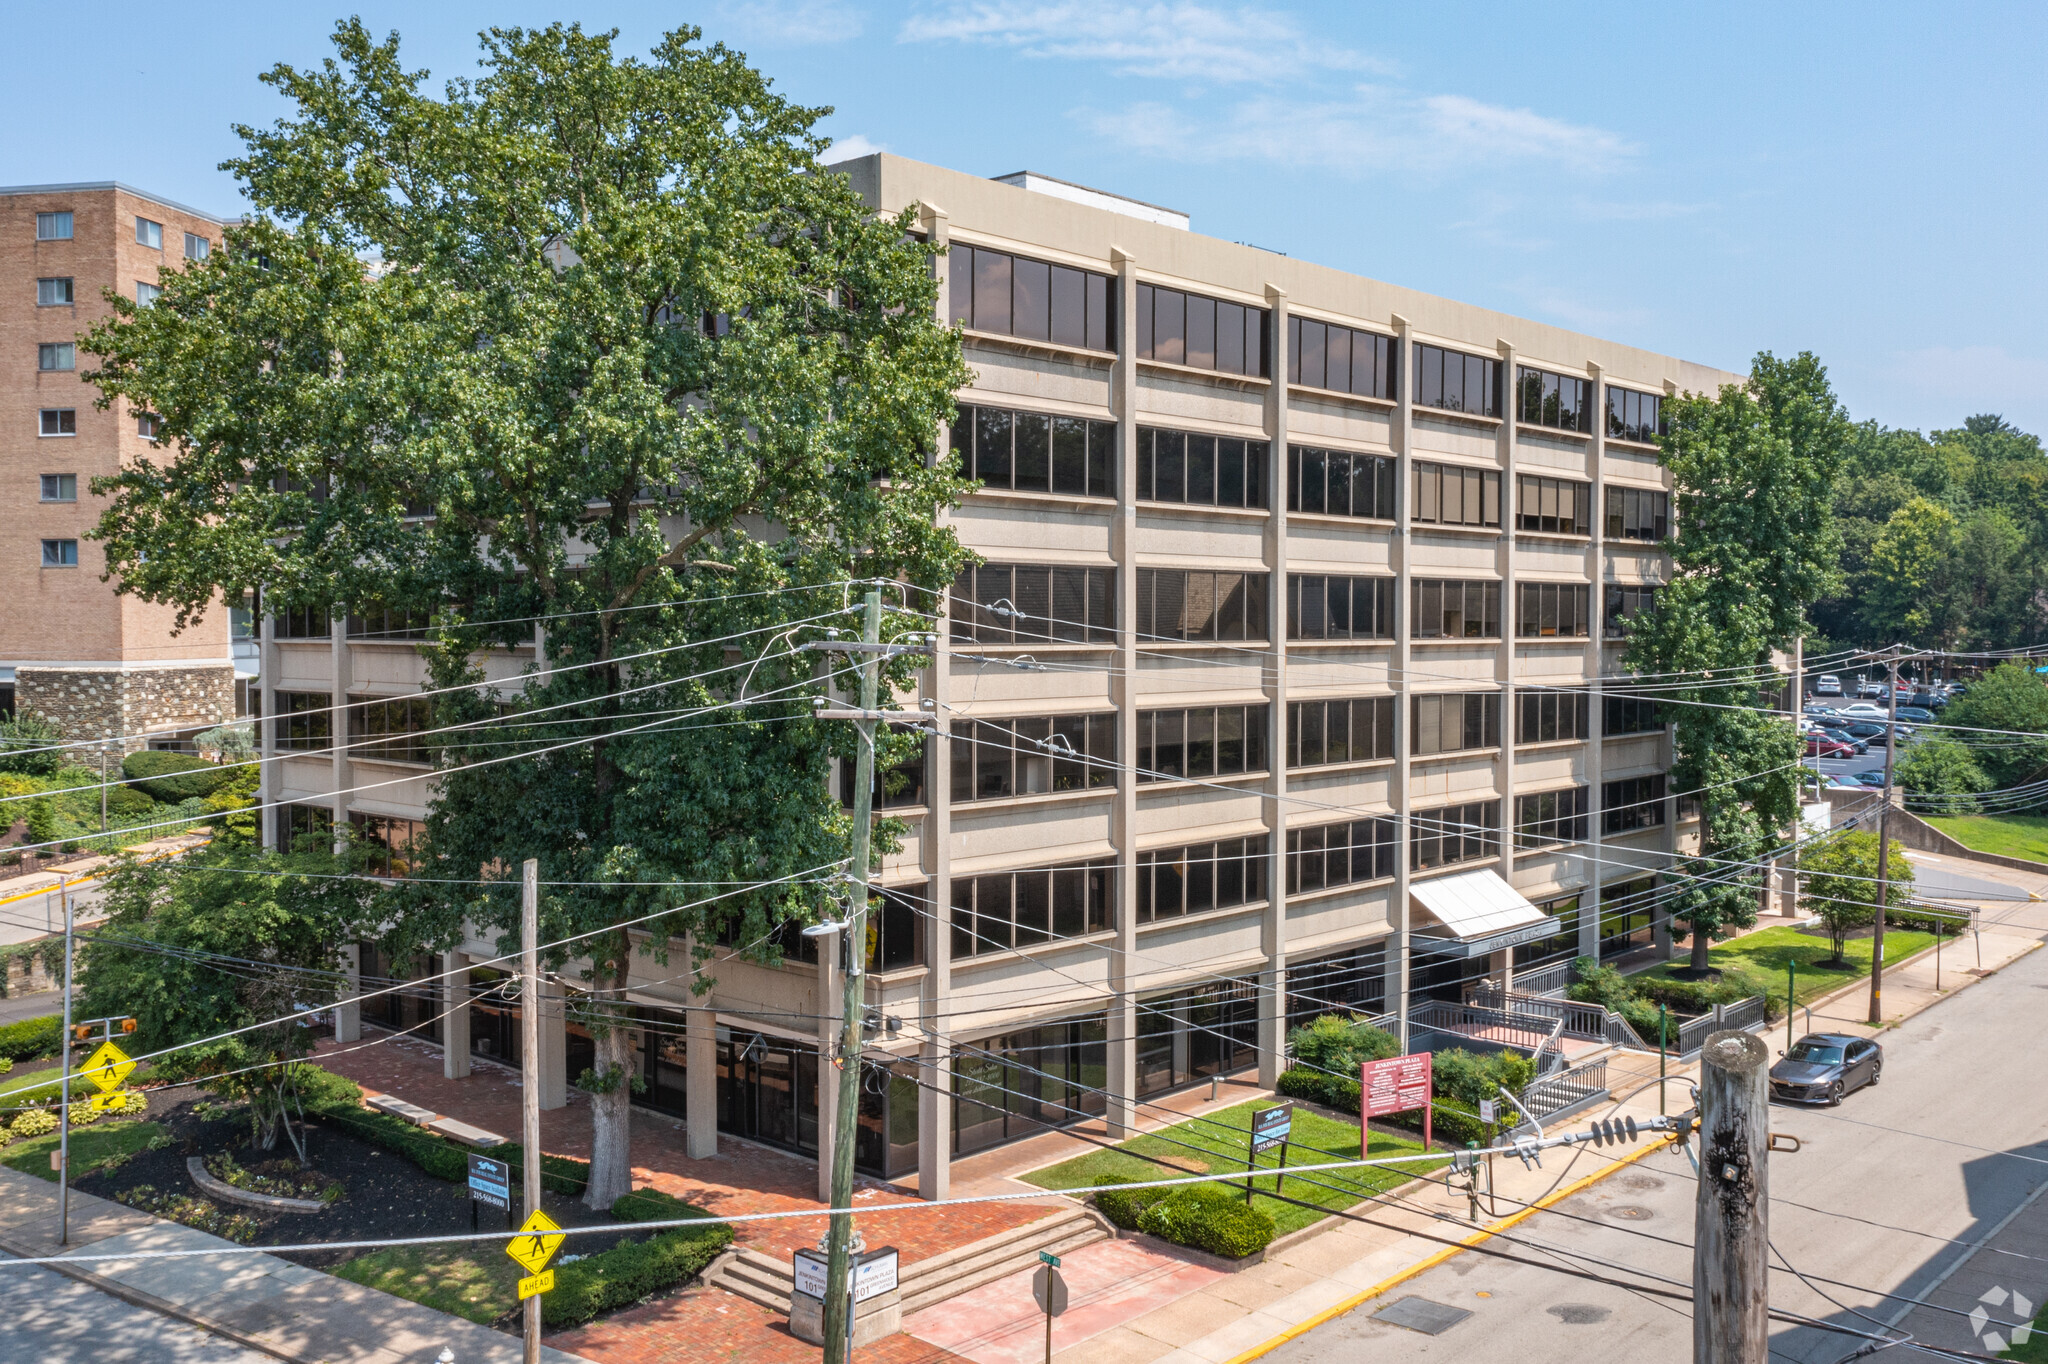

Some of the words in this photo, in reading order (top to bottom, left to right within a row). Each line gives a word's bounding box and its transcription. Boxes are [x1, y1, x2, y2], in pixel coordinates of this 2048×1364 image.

[1375, 1059, 1404, 1069] JENKINTOWN
[473, 1190, 504, 1207] 215-568-8000
[1040, 1253, 1051, 1263] WEST
[879, 1269, 895, 1279] PLAZA
[524, 1276, 549, 1292] AHEAD
[804, 1281, 818, 1294] 101
[856, 1286, 870, 1298] 101
